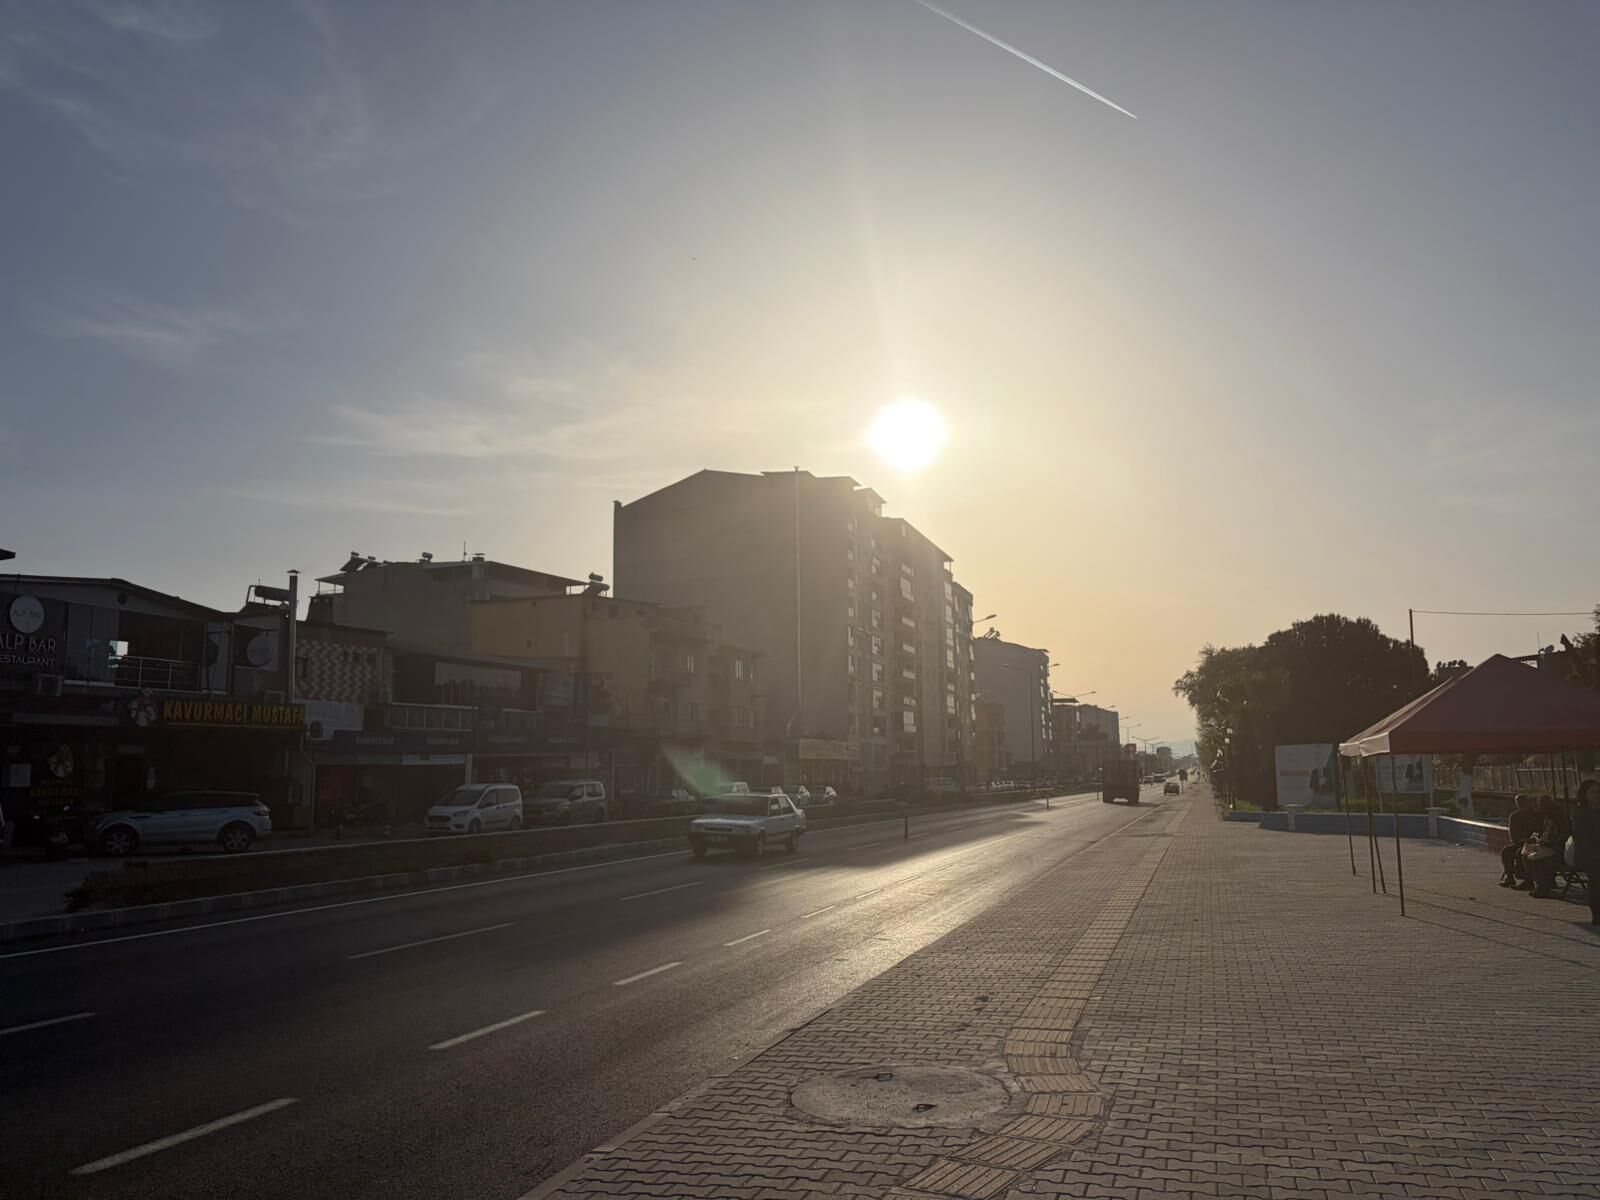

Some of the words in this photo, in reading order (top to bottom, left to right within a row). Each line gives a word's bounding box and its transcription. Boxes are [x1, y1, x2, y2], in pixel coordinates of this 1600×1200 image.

[29, 636, 56, 653] BAR
[164, 701, 247, 723] KAVURMACI
[251, 704, 304, 726] MUSTAFA
